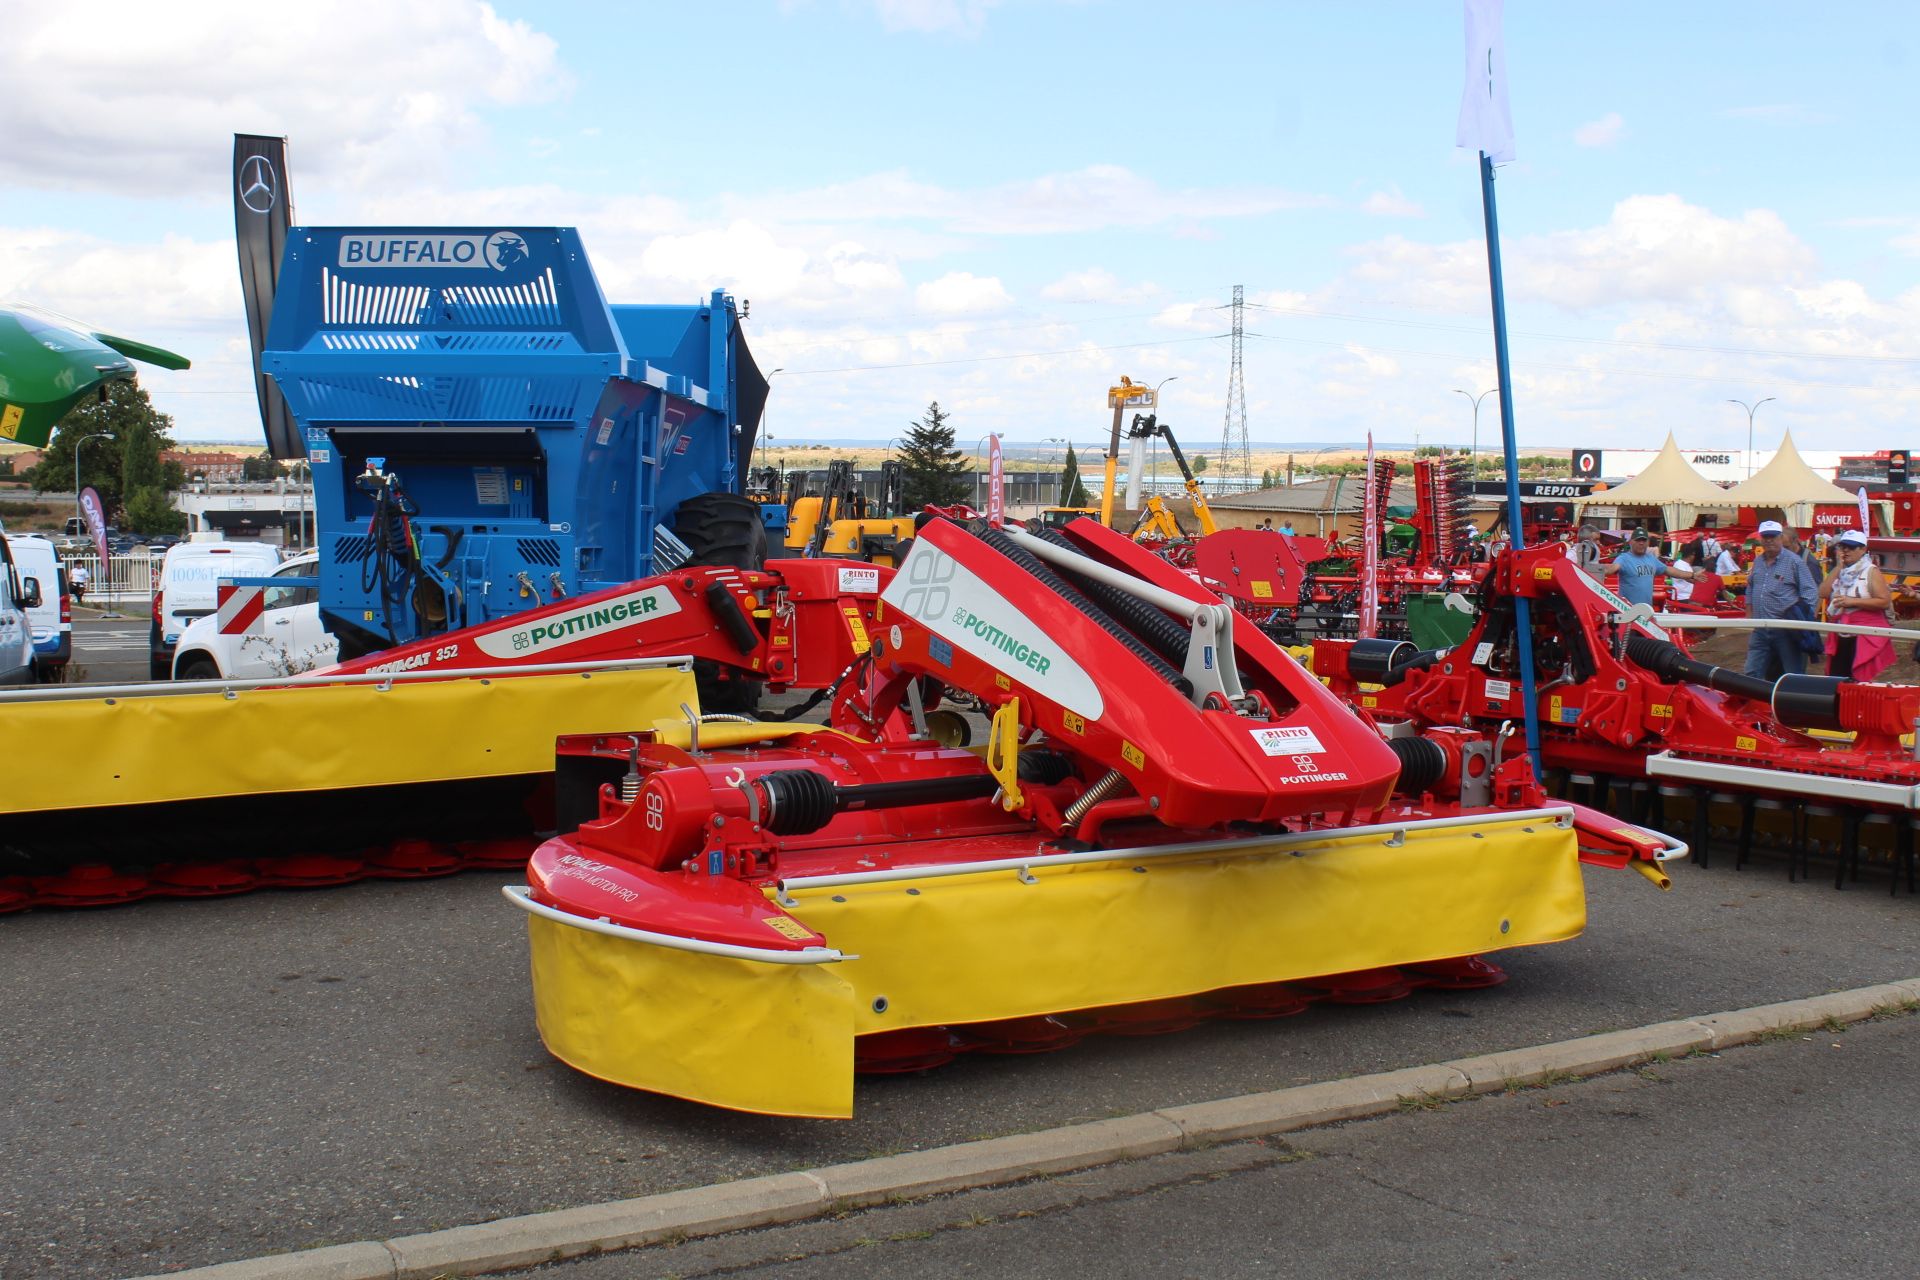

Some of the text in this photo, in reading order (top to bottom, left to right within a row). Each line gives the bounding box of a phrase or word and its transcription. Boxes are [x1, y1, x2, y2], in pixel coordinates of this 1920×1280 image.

[346, 240, 476, 263] BUFFALO
[1692, 452, 1730, 464] ANDRÉS
[1534, 485, 1581, 497] REPSOL
[1816, 512, 1852, 525] SÁNCHEZ
[848, 570, 875, 578] PINTO
[436, 644, 458, 662] 352
[1265, 728, 1308, 739] PINTO
[557, 854, 613, 873] NOVACAT
[584, 873, 620, 894] MOTION
[614, 888, 639, 903] PRO
